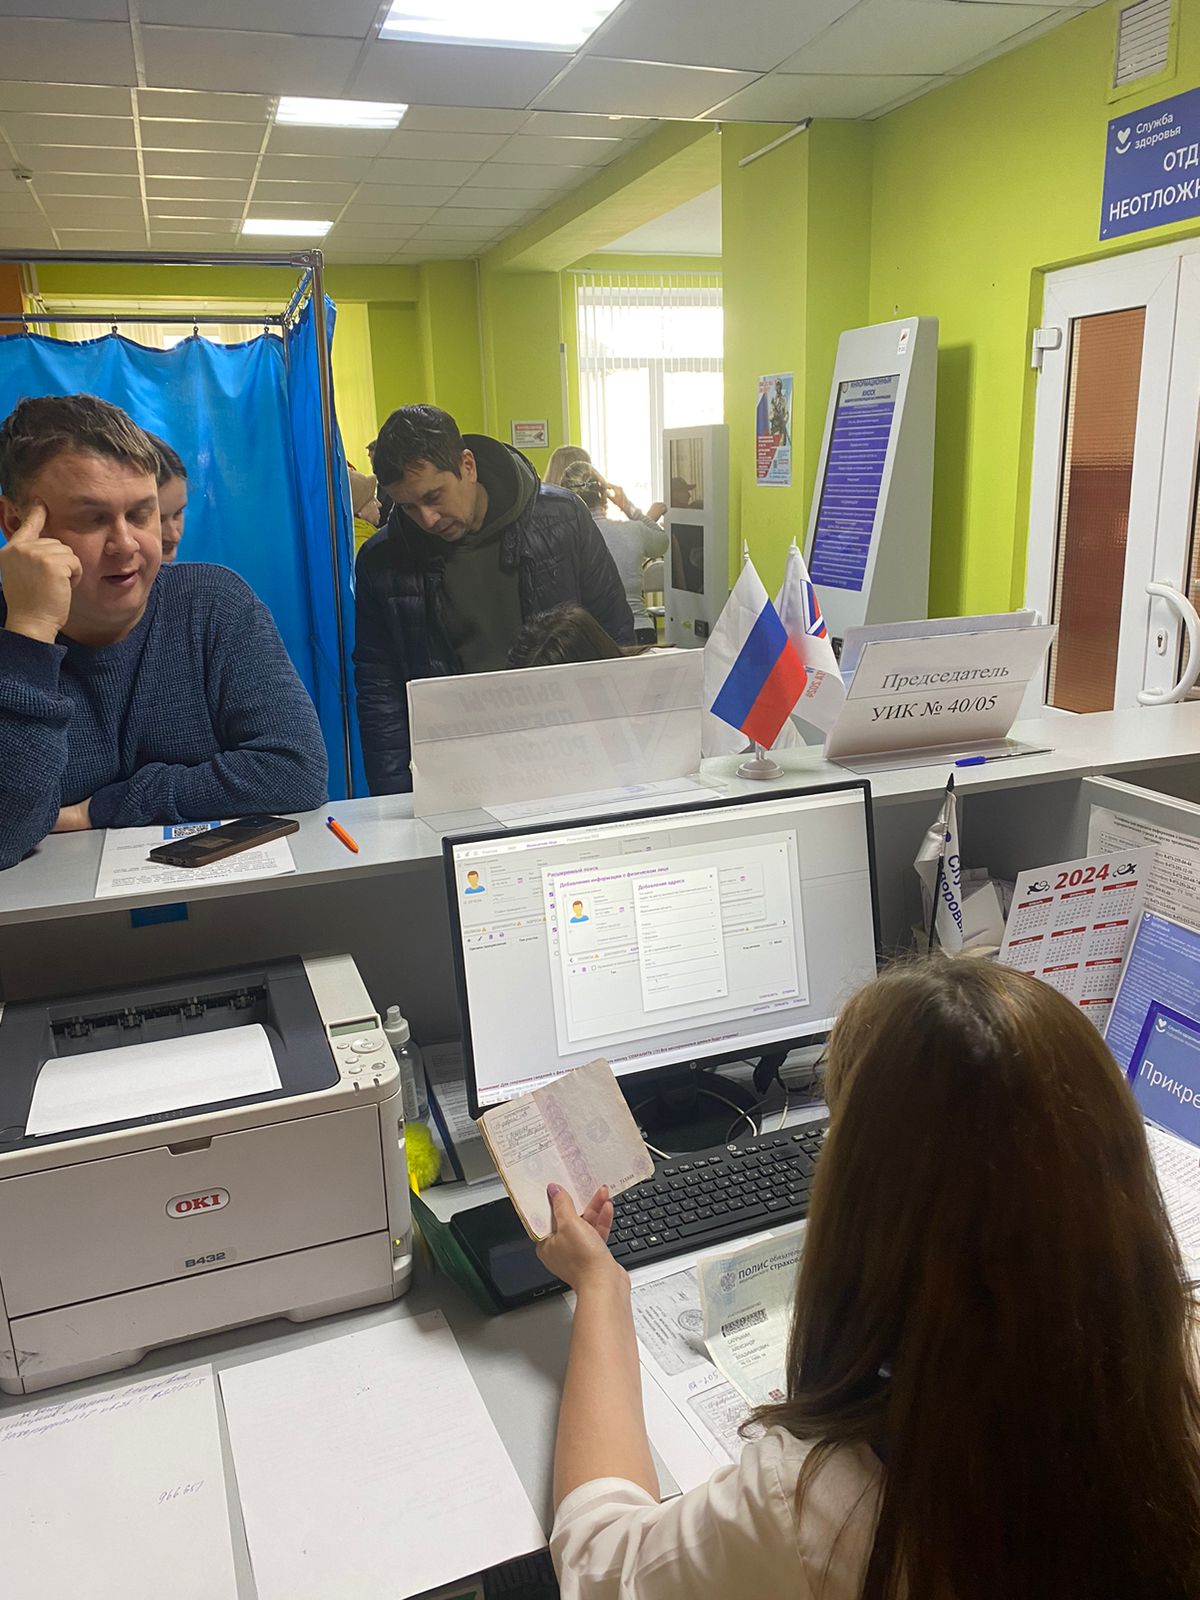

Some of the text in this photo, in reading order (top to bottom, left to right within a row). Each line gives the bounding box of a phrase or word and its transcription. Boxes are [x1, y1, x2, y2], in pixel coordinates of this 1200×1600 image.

[1136, 113, 1173, 134] Служба
[1135, 126, 1181, 150] здоровья
[882, 666, 1009, 691] Председатель
[872, 696, 998, 722] УИК № 40/05
[1054, 864, 1110, 890] 2024
[176, 1194, 221, 1213] OKI
[185, 1252, 226, 1268] B432
[738, 1260, 768, 1279] ПОЛИС
